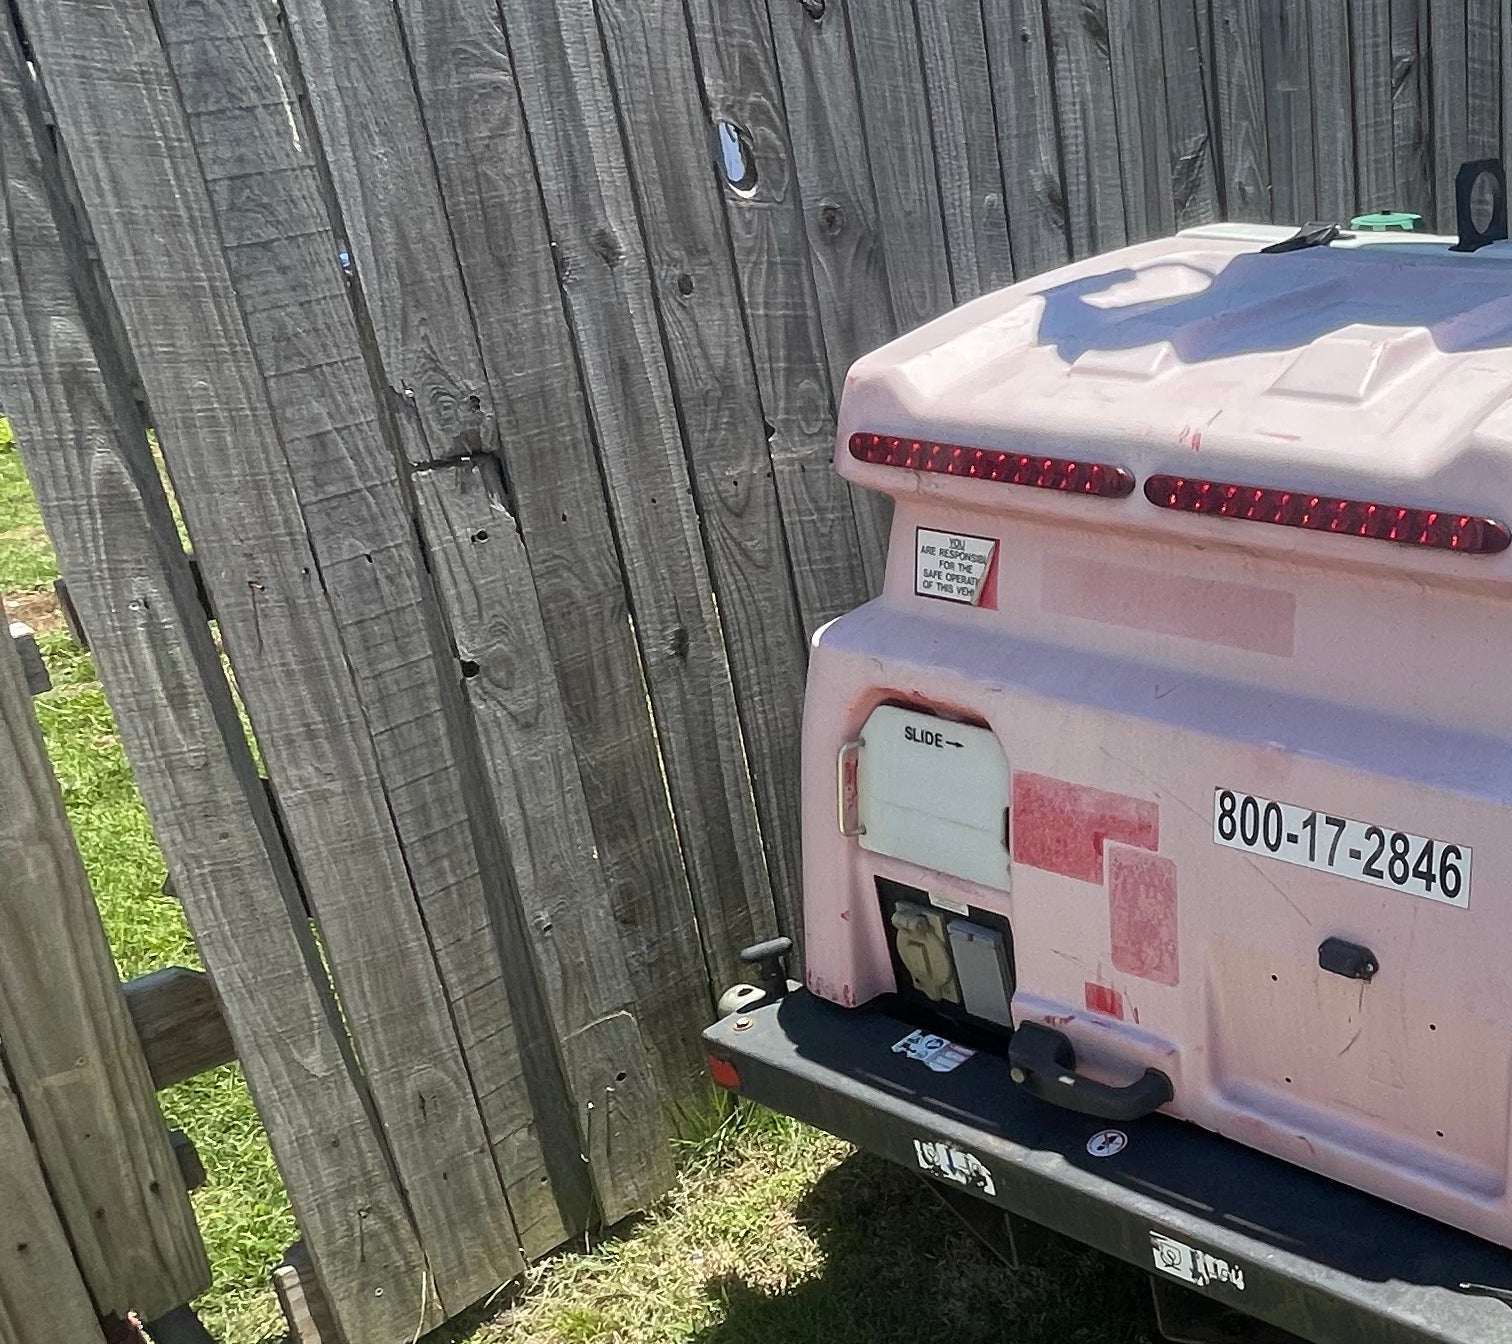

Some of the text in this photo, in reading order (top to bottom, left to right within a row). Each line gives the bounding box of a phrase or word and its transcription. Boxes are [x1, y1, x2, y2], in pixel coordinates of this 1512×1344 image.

[920, 545, 936, 555] ARE
[949, 538, 966, 550] YOU
[939, 560, 973, 574] FOR THE
[923, 568, 943, 581] SAFE
[922, 580, 935, 590] OF
[937, 581, 953, 594] THIS
[904, 726, 944, 749] SLIDE
[1217, 790, 1463, 898] 800-17-2846
